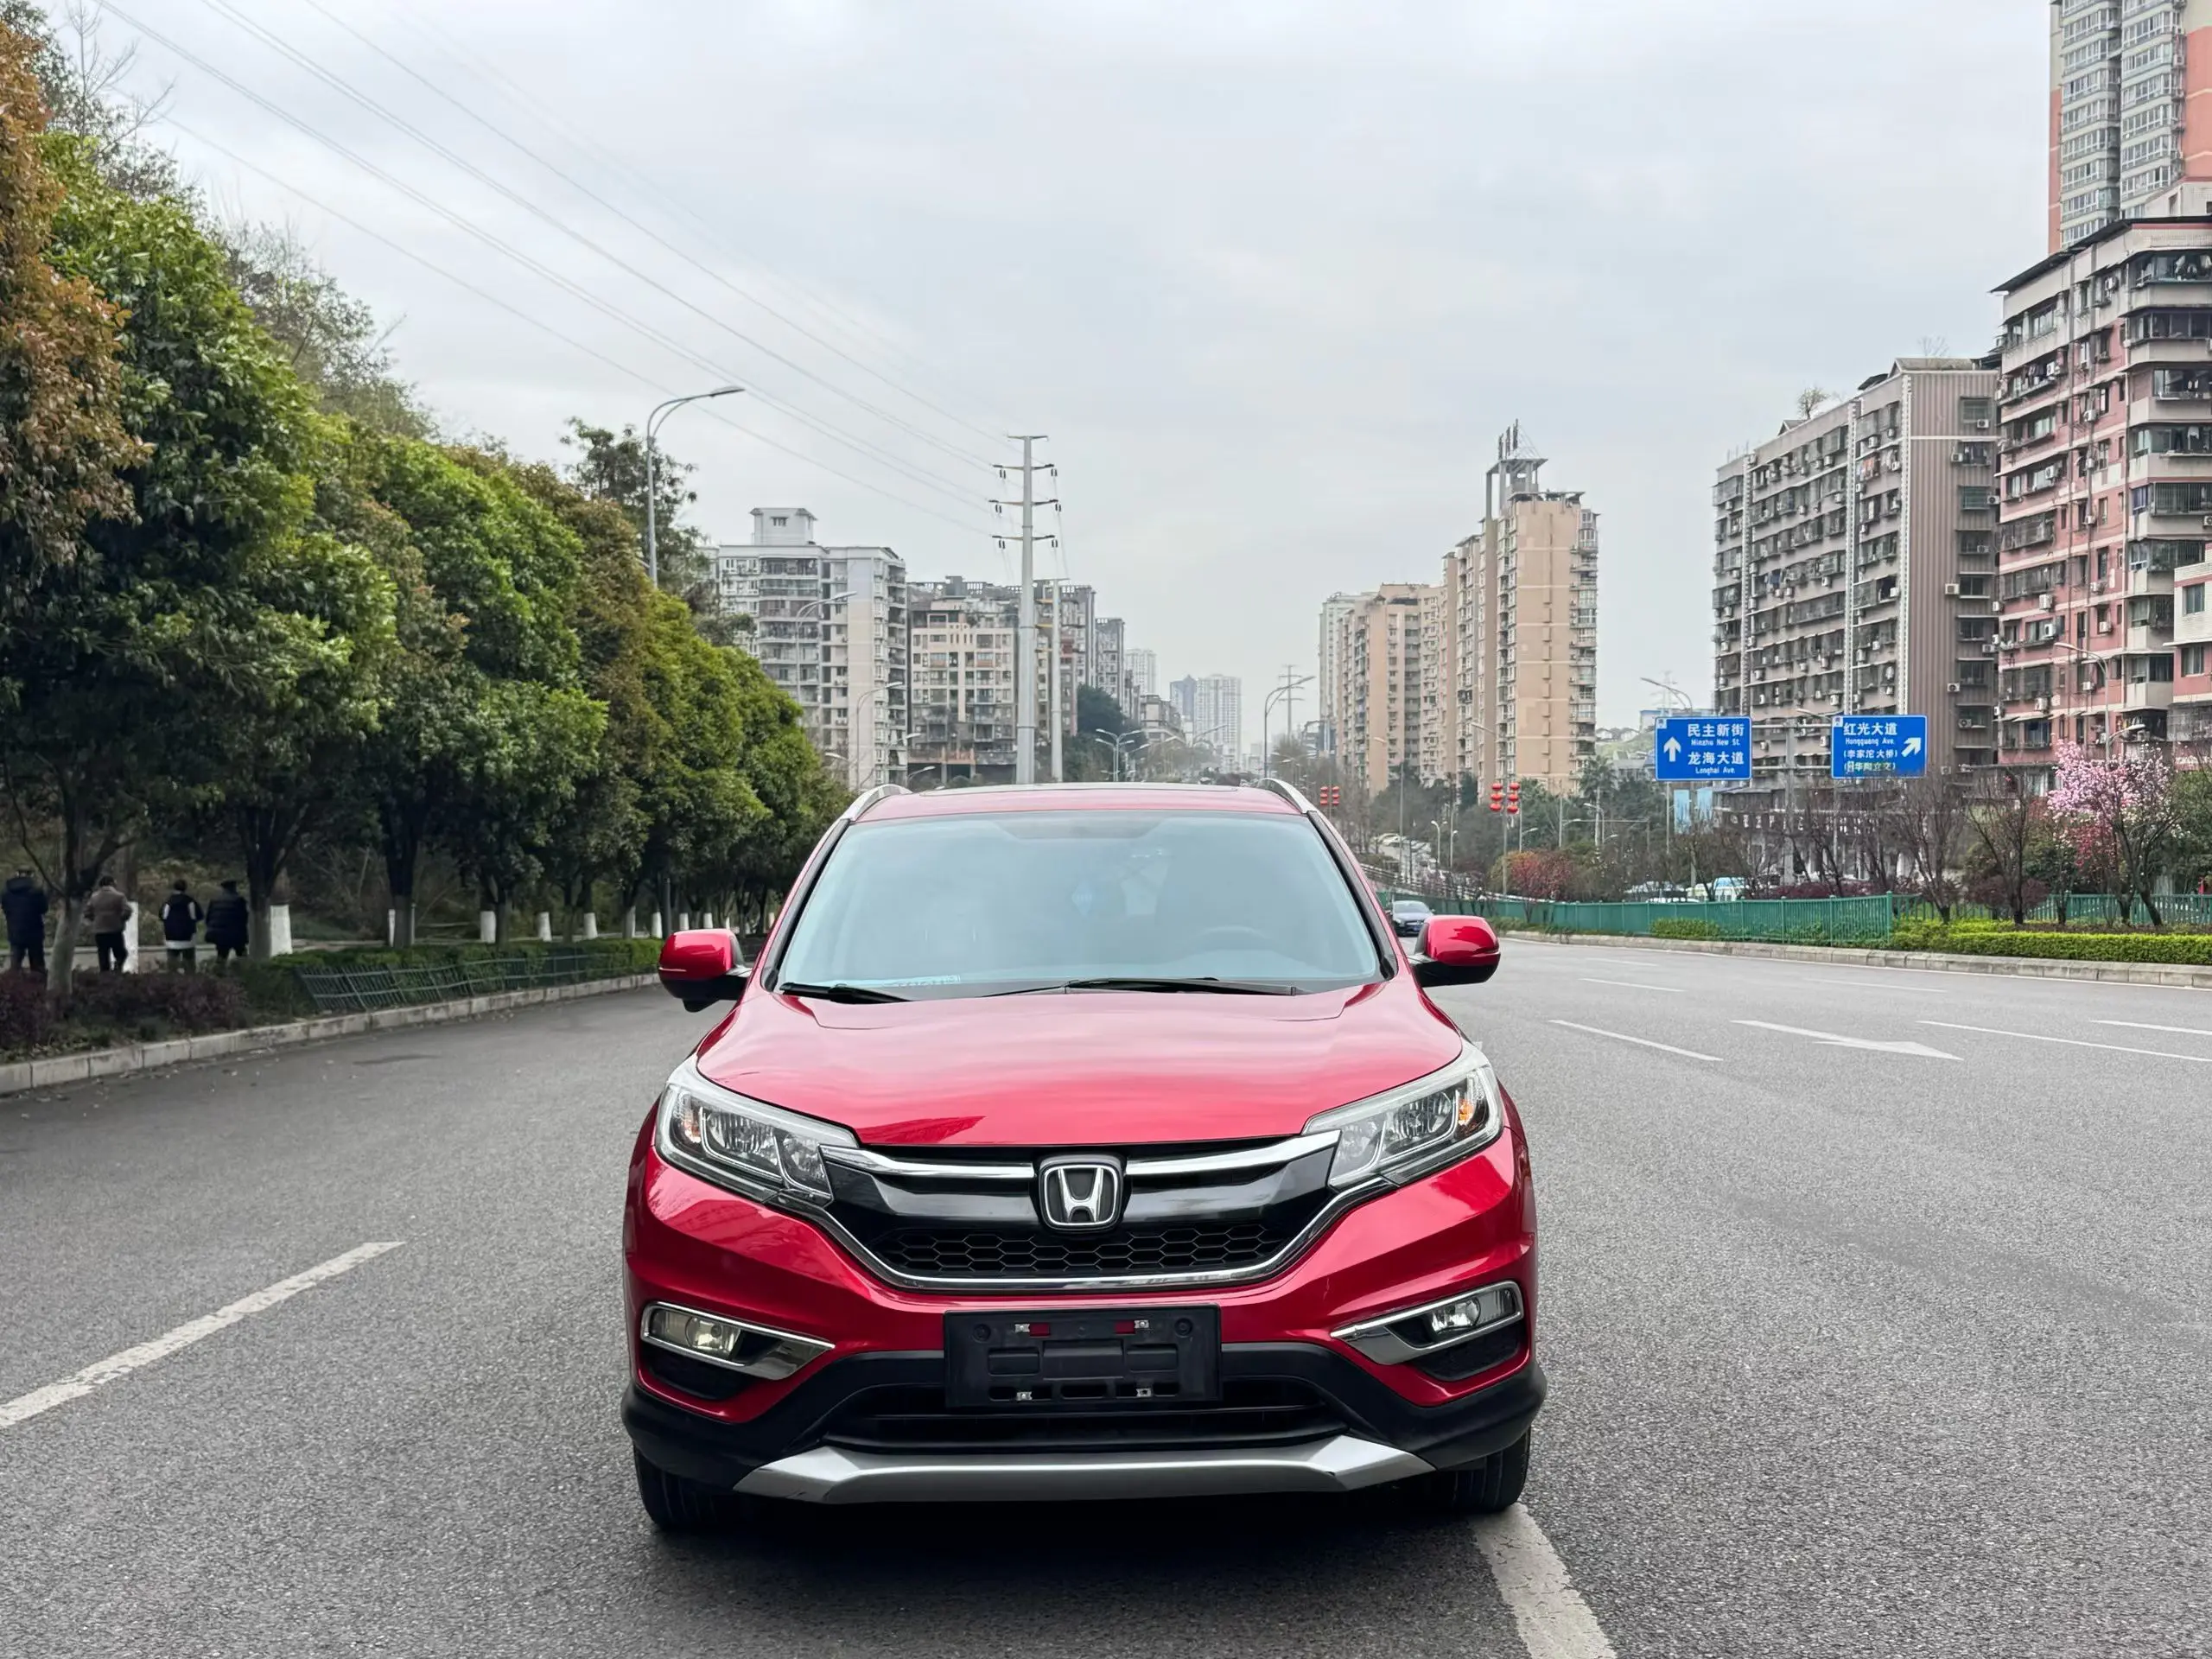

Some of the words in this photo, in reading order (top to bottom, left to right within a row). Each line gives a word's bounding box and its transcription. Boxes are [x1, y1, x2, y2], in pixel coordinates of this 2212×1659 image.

[1688, 723, 1745, 737] 民主新街
[1843, 722, 1897, 735] 红光大道
[1688, 751, 1744, 765] 龙海大道
[1695, 766, 1719, 776] Longhai
